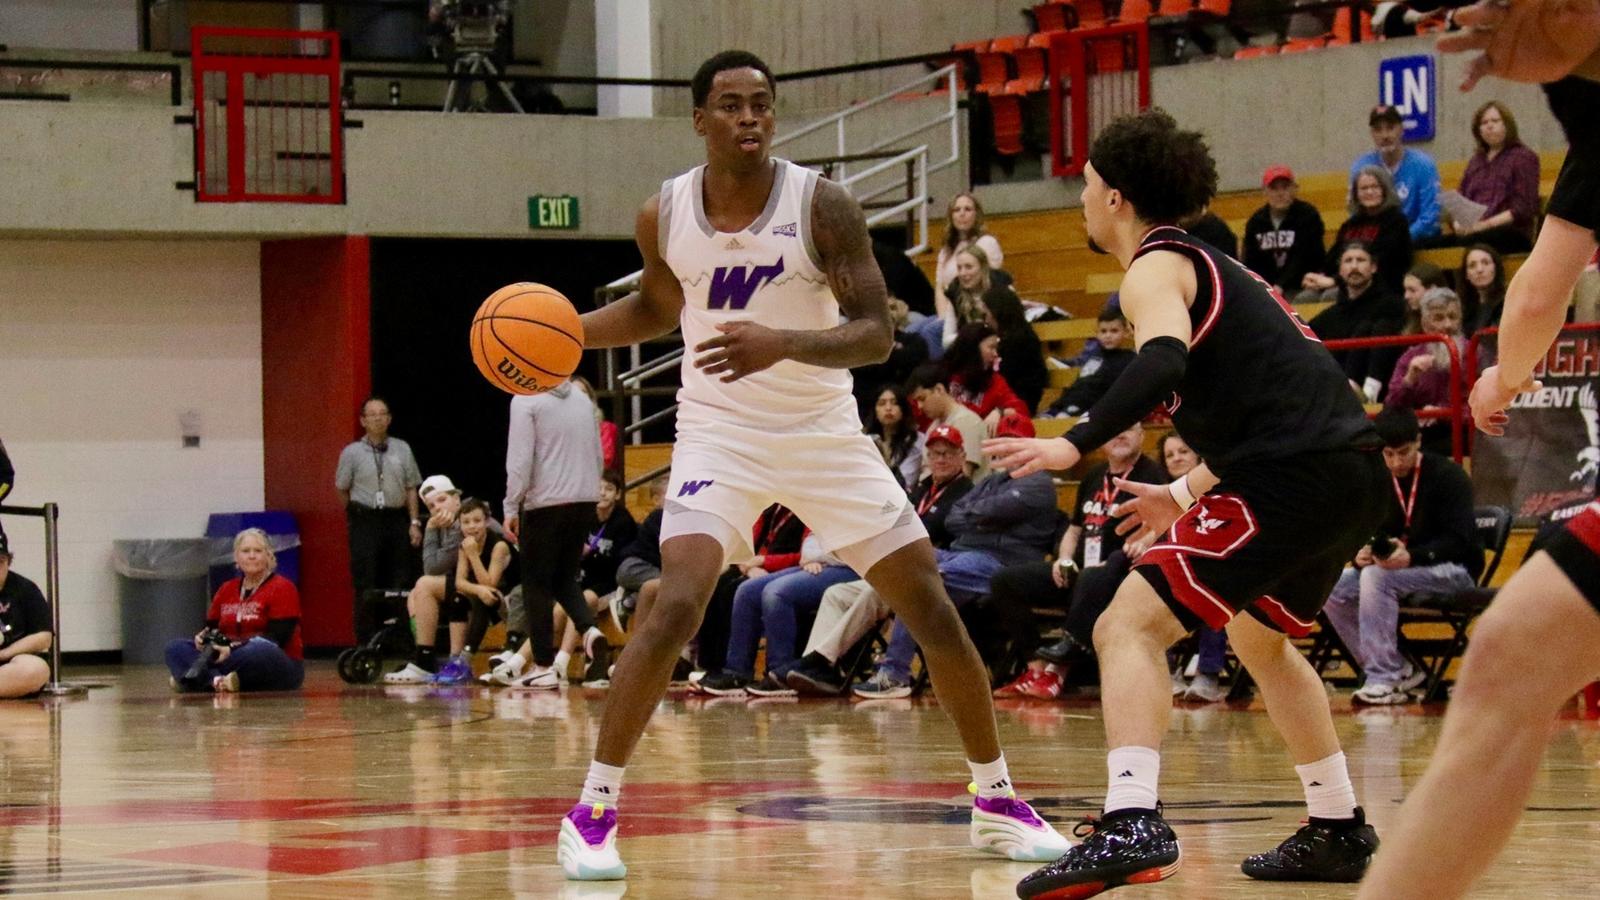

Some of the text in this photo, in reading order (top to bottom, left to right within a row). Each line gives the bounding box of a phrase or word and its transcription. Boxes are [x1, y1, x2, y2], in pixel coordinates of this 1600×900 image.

[1384, 66, 1428, 115] LN
[539, 198, 570, 226] EXIT
[497, 357, 560, 393] Wilso
